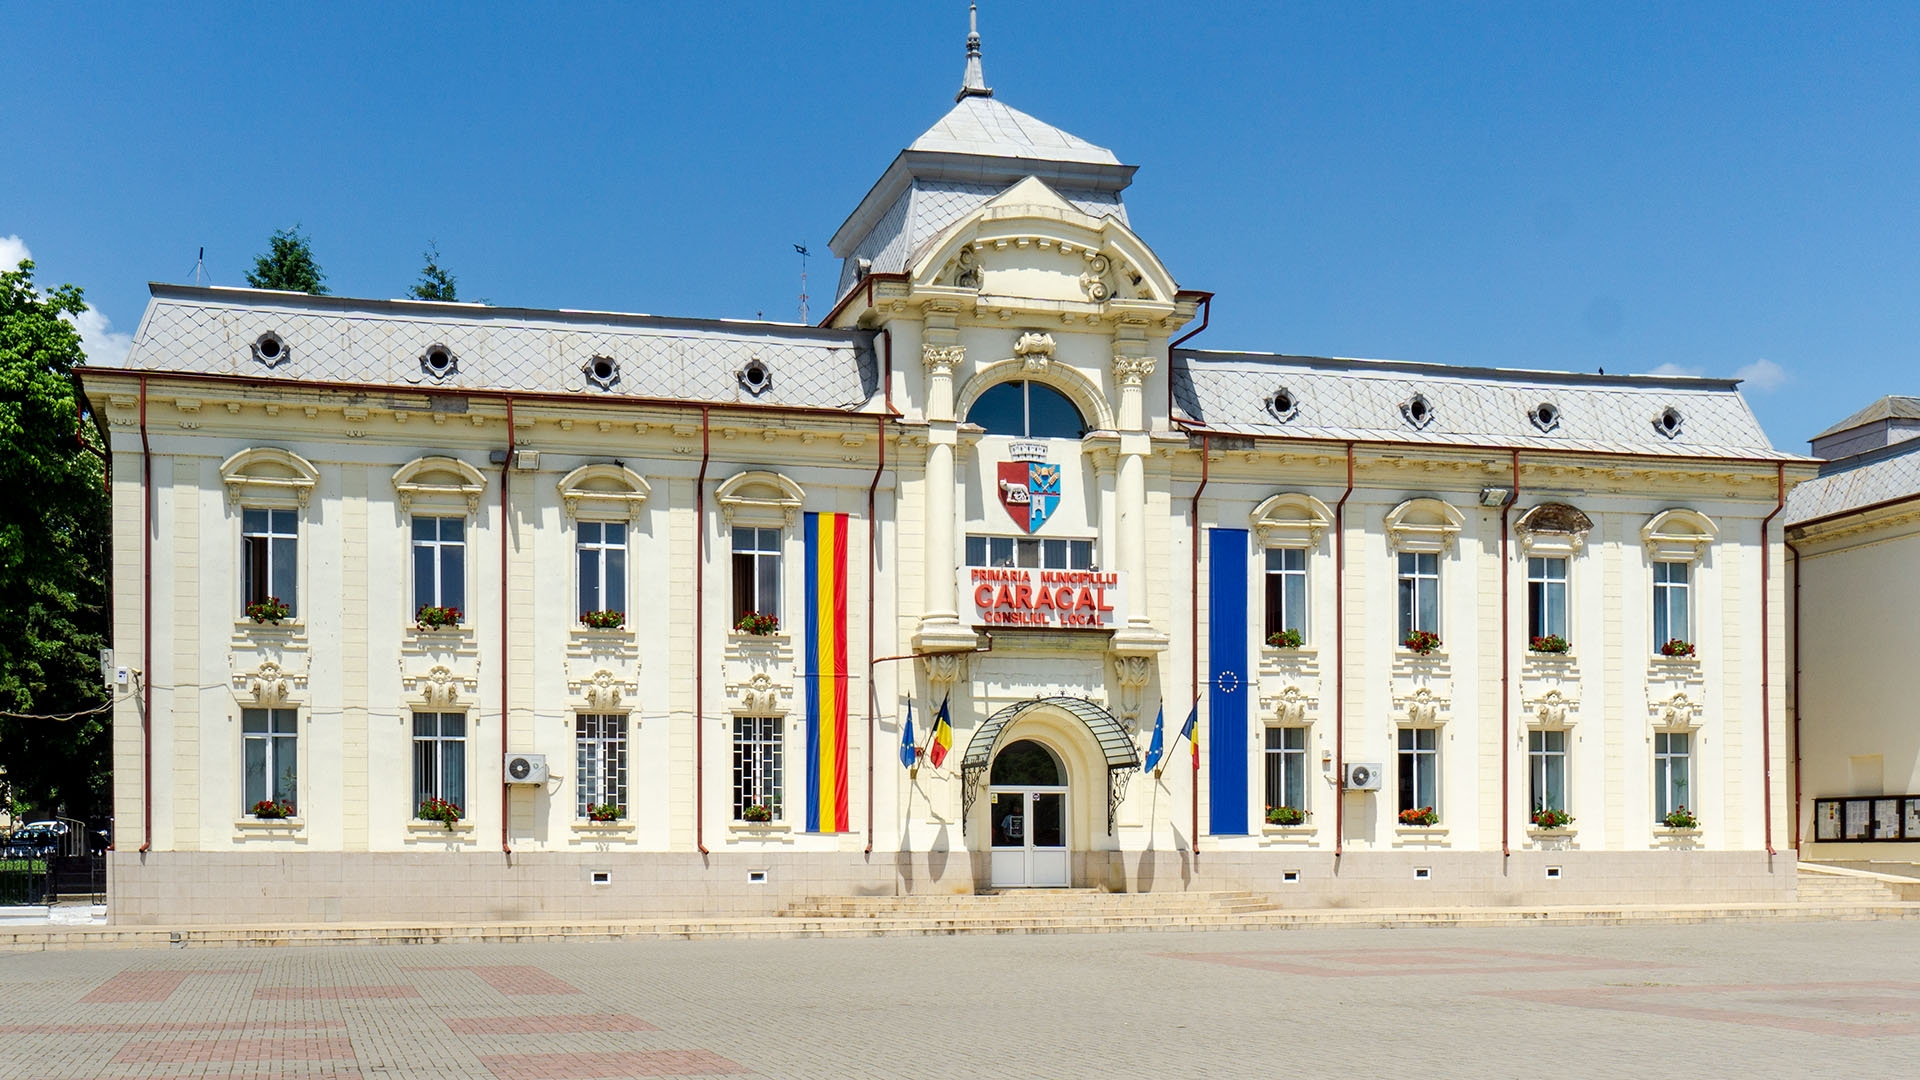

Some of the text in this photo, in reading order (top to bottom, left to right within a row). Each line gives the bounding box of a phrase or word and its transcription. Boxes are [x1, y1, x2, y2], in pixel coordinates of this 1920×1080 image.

[971, 569, 1118, 584] PRIMARIA MUNICIPIULUI
[974, 583, 1114, 611] CARACAL
[984, 611, 1105, 626] CONSILIUL LOCAL
